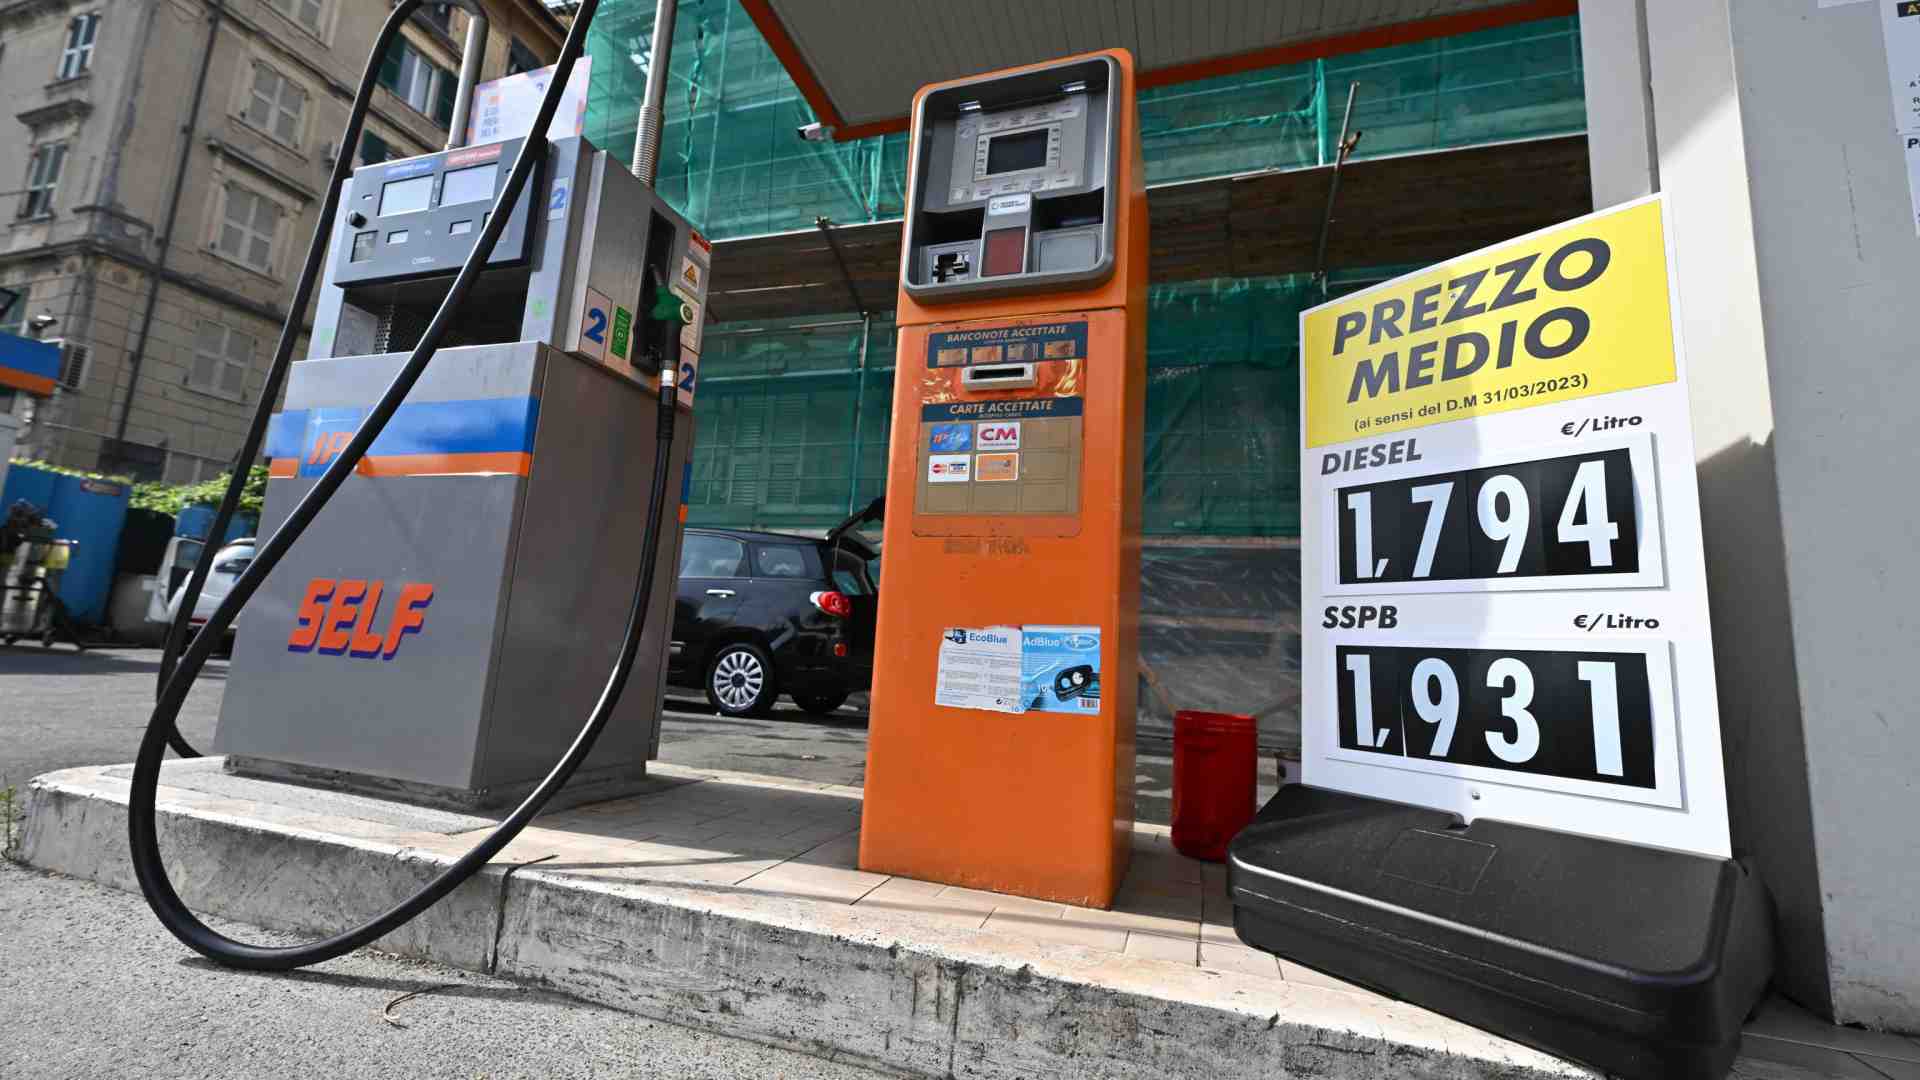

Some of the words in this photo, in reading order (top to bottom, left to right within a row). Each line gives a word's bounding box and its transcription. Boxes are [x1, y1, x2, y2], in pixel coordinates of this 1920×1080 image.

[551, 187, 568, 209] 2
[1332, 237, 1612, 356] PREZZO
[584, 307, 608, 345] 2
[946, 329, 1008, 343] BANCONOTE
[1011, 325, 1068, 338] ACCETTATE
[1346, 306, 1591, 404] MEDIO
[679, 362, 696, 394] 2
[949, 403, 985, 415] CARTE
[988, 400, 1053, 413] ACCETTATE
[1354, 416, 1371, 433] (ai
[1375, 411, 1413, 427] sensi
[1418, 404, 1441, 418] del
[1446, 395, 1478, 412] D.M
[1483, 372, 1589, 405] 31/03/2023)
[979, 427, 1018, 441] CM
[1321, 438, 1423, 476] DIESEL
[1347, 459, 1619, 579] 1,794
[288, 577, 434, 661] SELF
[1321, 604, 1399, 630] SSPB
[969, 631, 1008, 645] EcoBlue
[1023, 636, 1060, 648] AdBlue
[1346, 653, 1624, 777] 1,931
